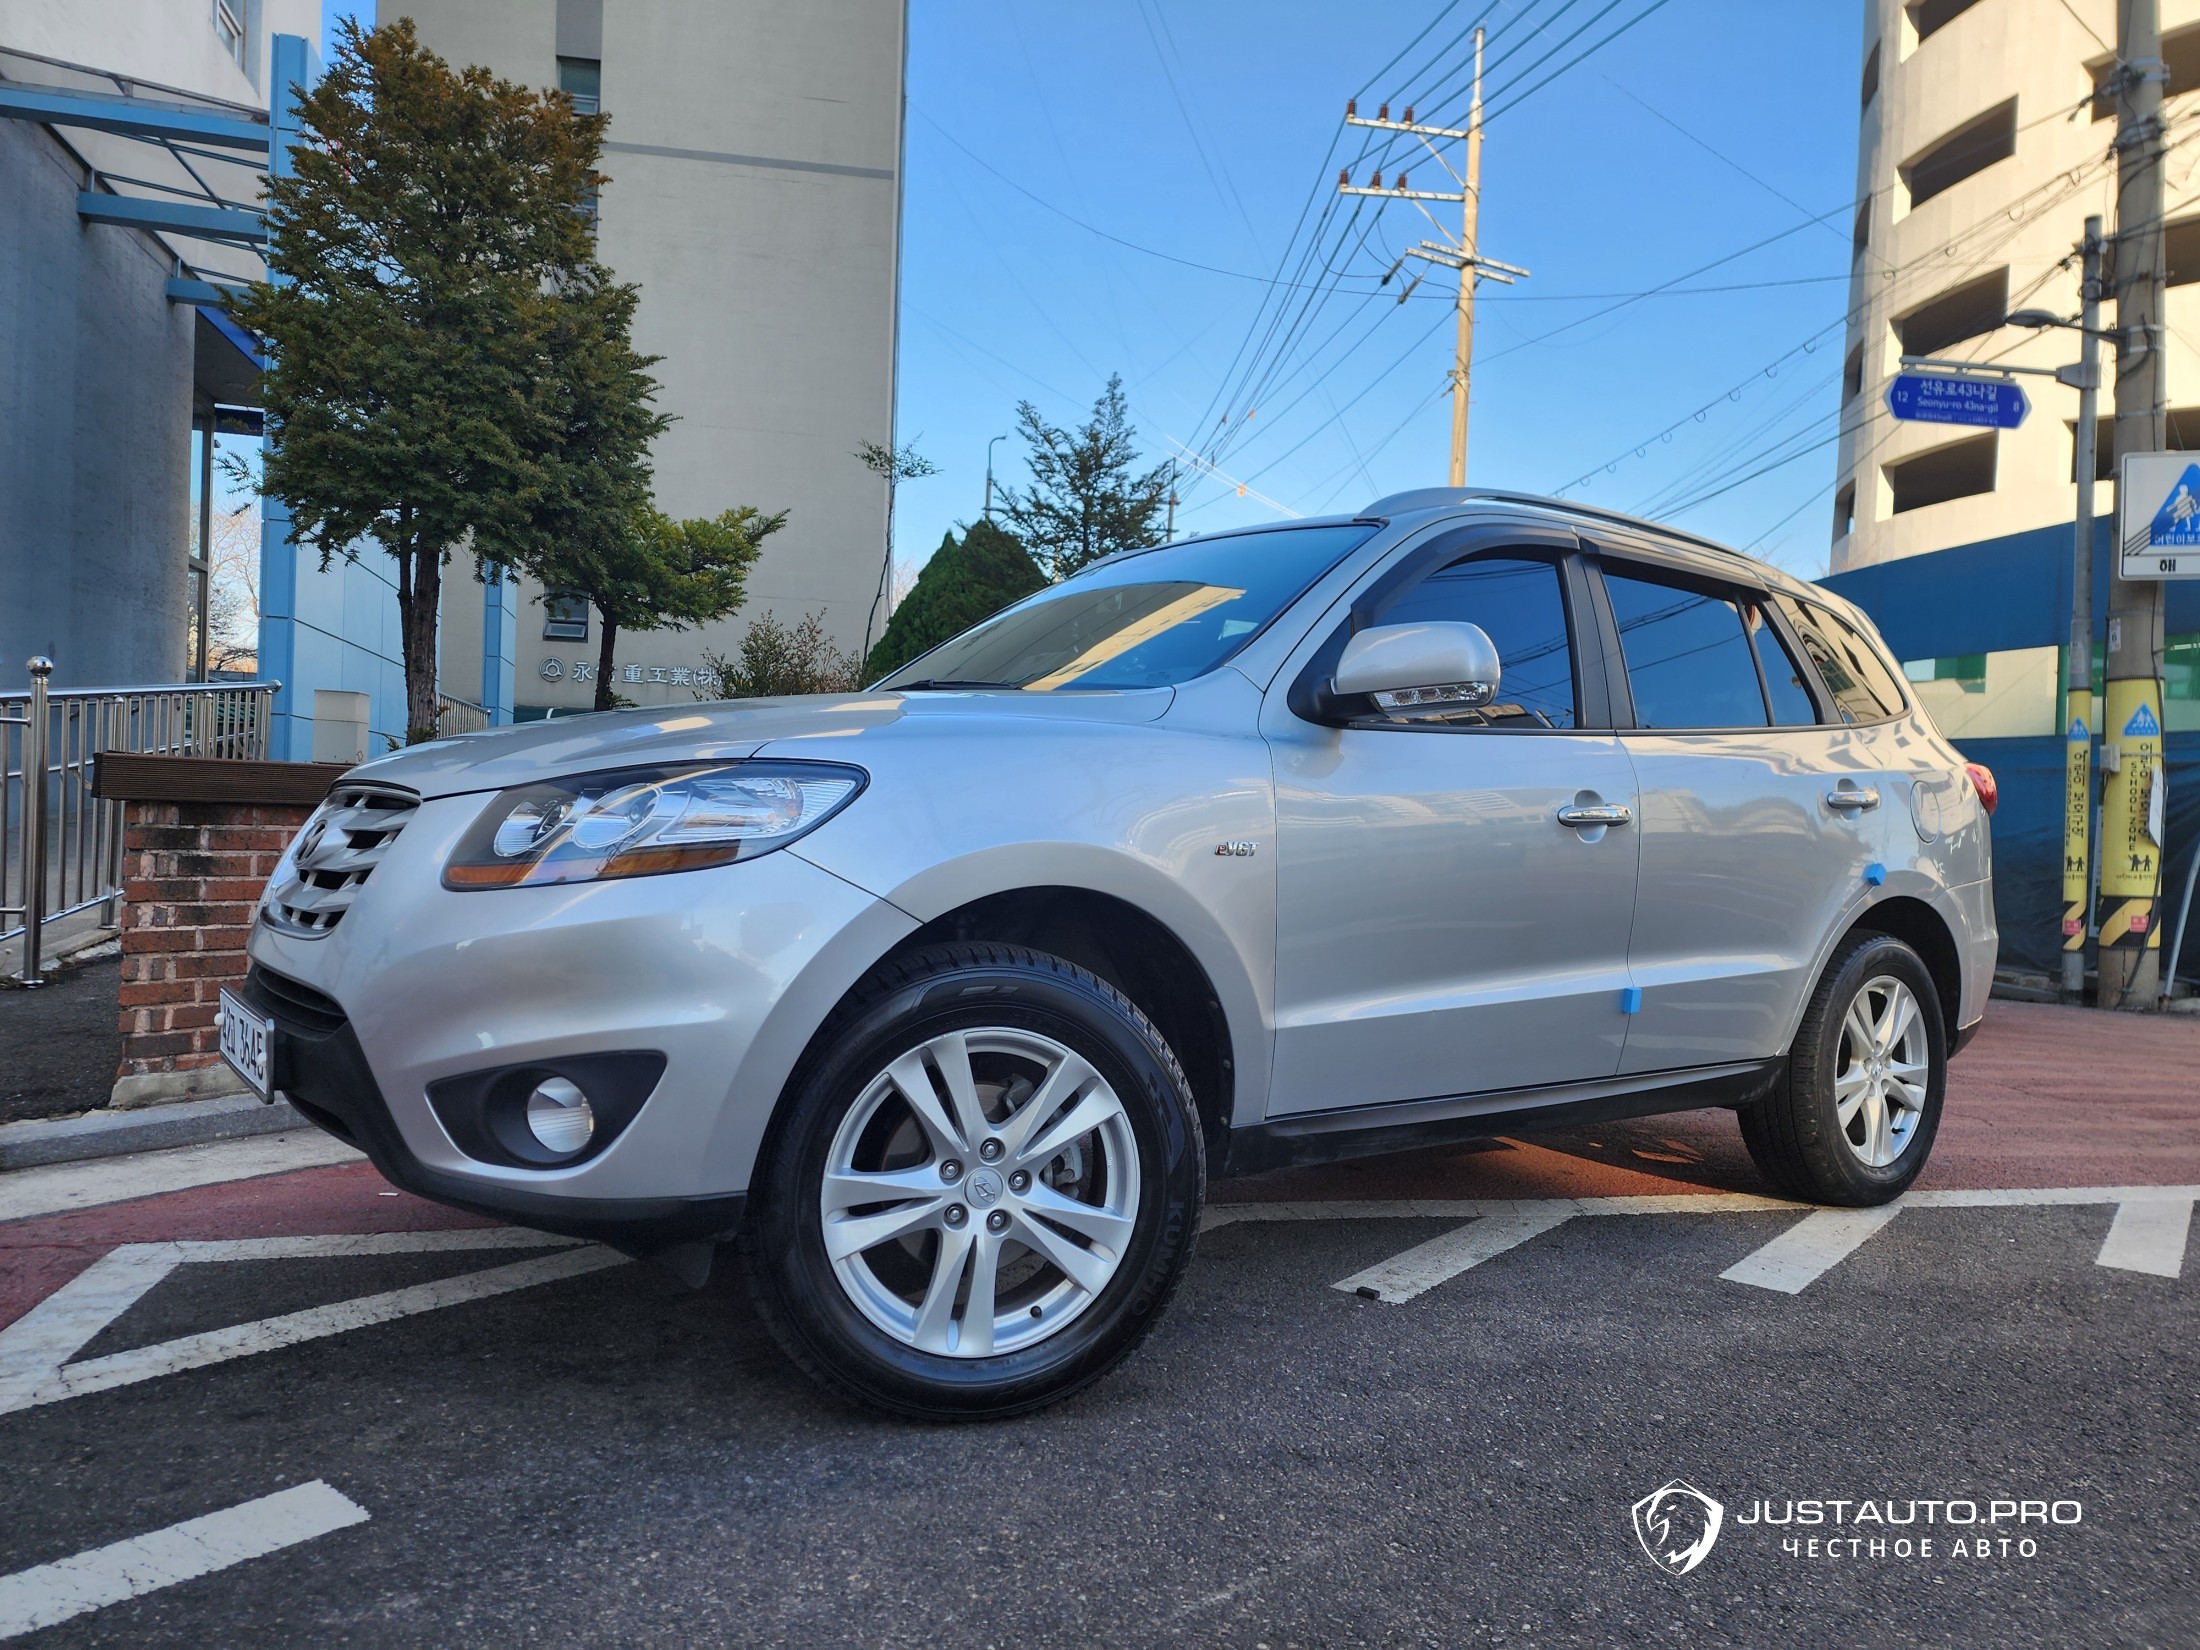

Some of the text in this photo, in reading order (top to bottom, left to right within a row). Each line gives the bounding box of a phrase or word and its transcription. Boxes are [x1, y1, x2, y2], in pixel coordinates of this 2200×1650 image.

[1897, 390, 1909, 403] 12
[1920, 379, 1998, 402] 선유로43나길
[1917, 395, 1999, 415] Seonyu-ro 43na-gil
[2129, 761, 2137, 852] SCHOOL ZONE
[1215, 841, 1260, 857] eVGT
[1131, 1199, 1186, 1317] KUMHO
